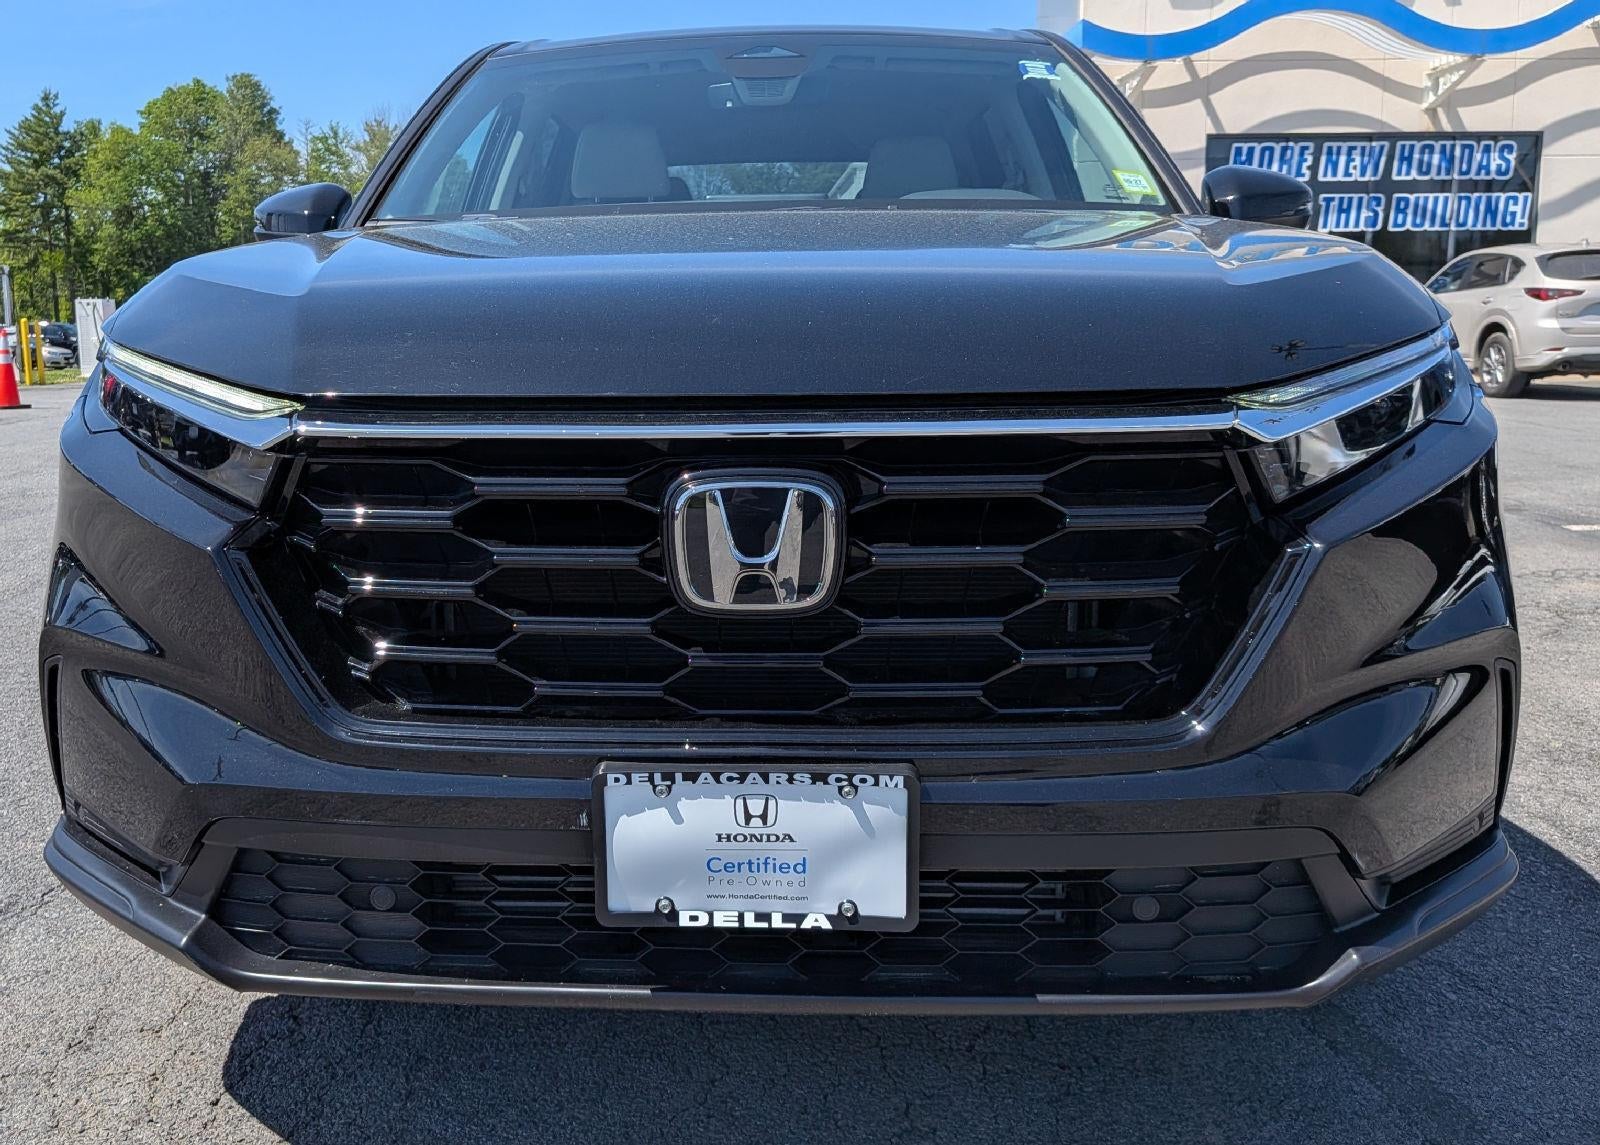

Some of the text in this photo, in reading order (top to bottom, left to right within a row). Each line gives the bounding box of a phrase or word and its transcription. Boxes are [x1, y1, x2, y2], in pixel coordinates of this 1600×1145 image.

[1229, 140, 1517, 181] MORE NEW HONDAS
[1318, 192, 1532, 232] THIS BUILDING!
[606, 772, 904, 788] DELLACARS.COM
[715, 832, 797, 843] HONDA
[706, 856, 807, 875] Certified
[707, 875, 806, 888] Pre-Owned
[706, 892, 809, 902] www.HondaCertified.com
[678, 910, 833, 929] DELLA
